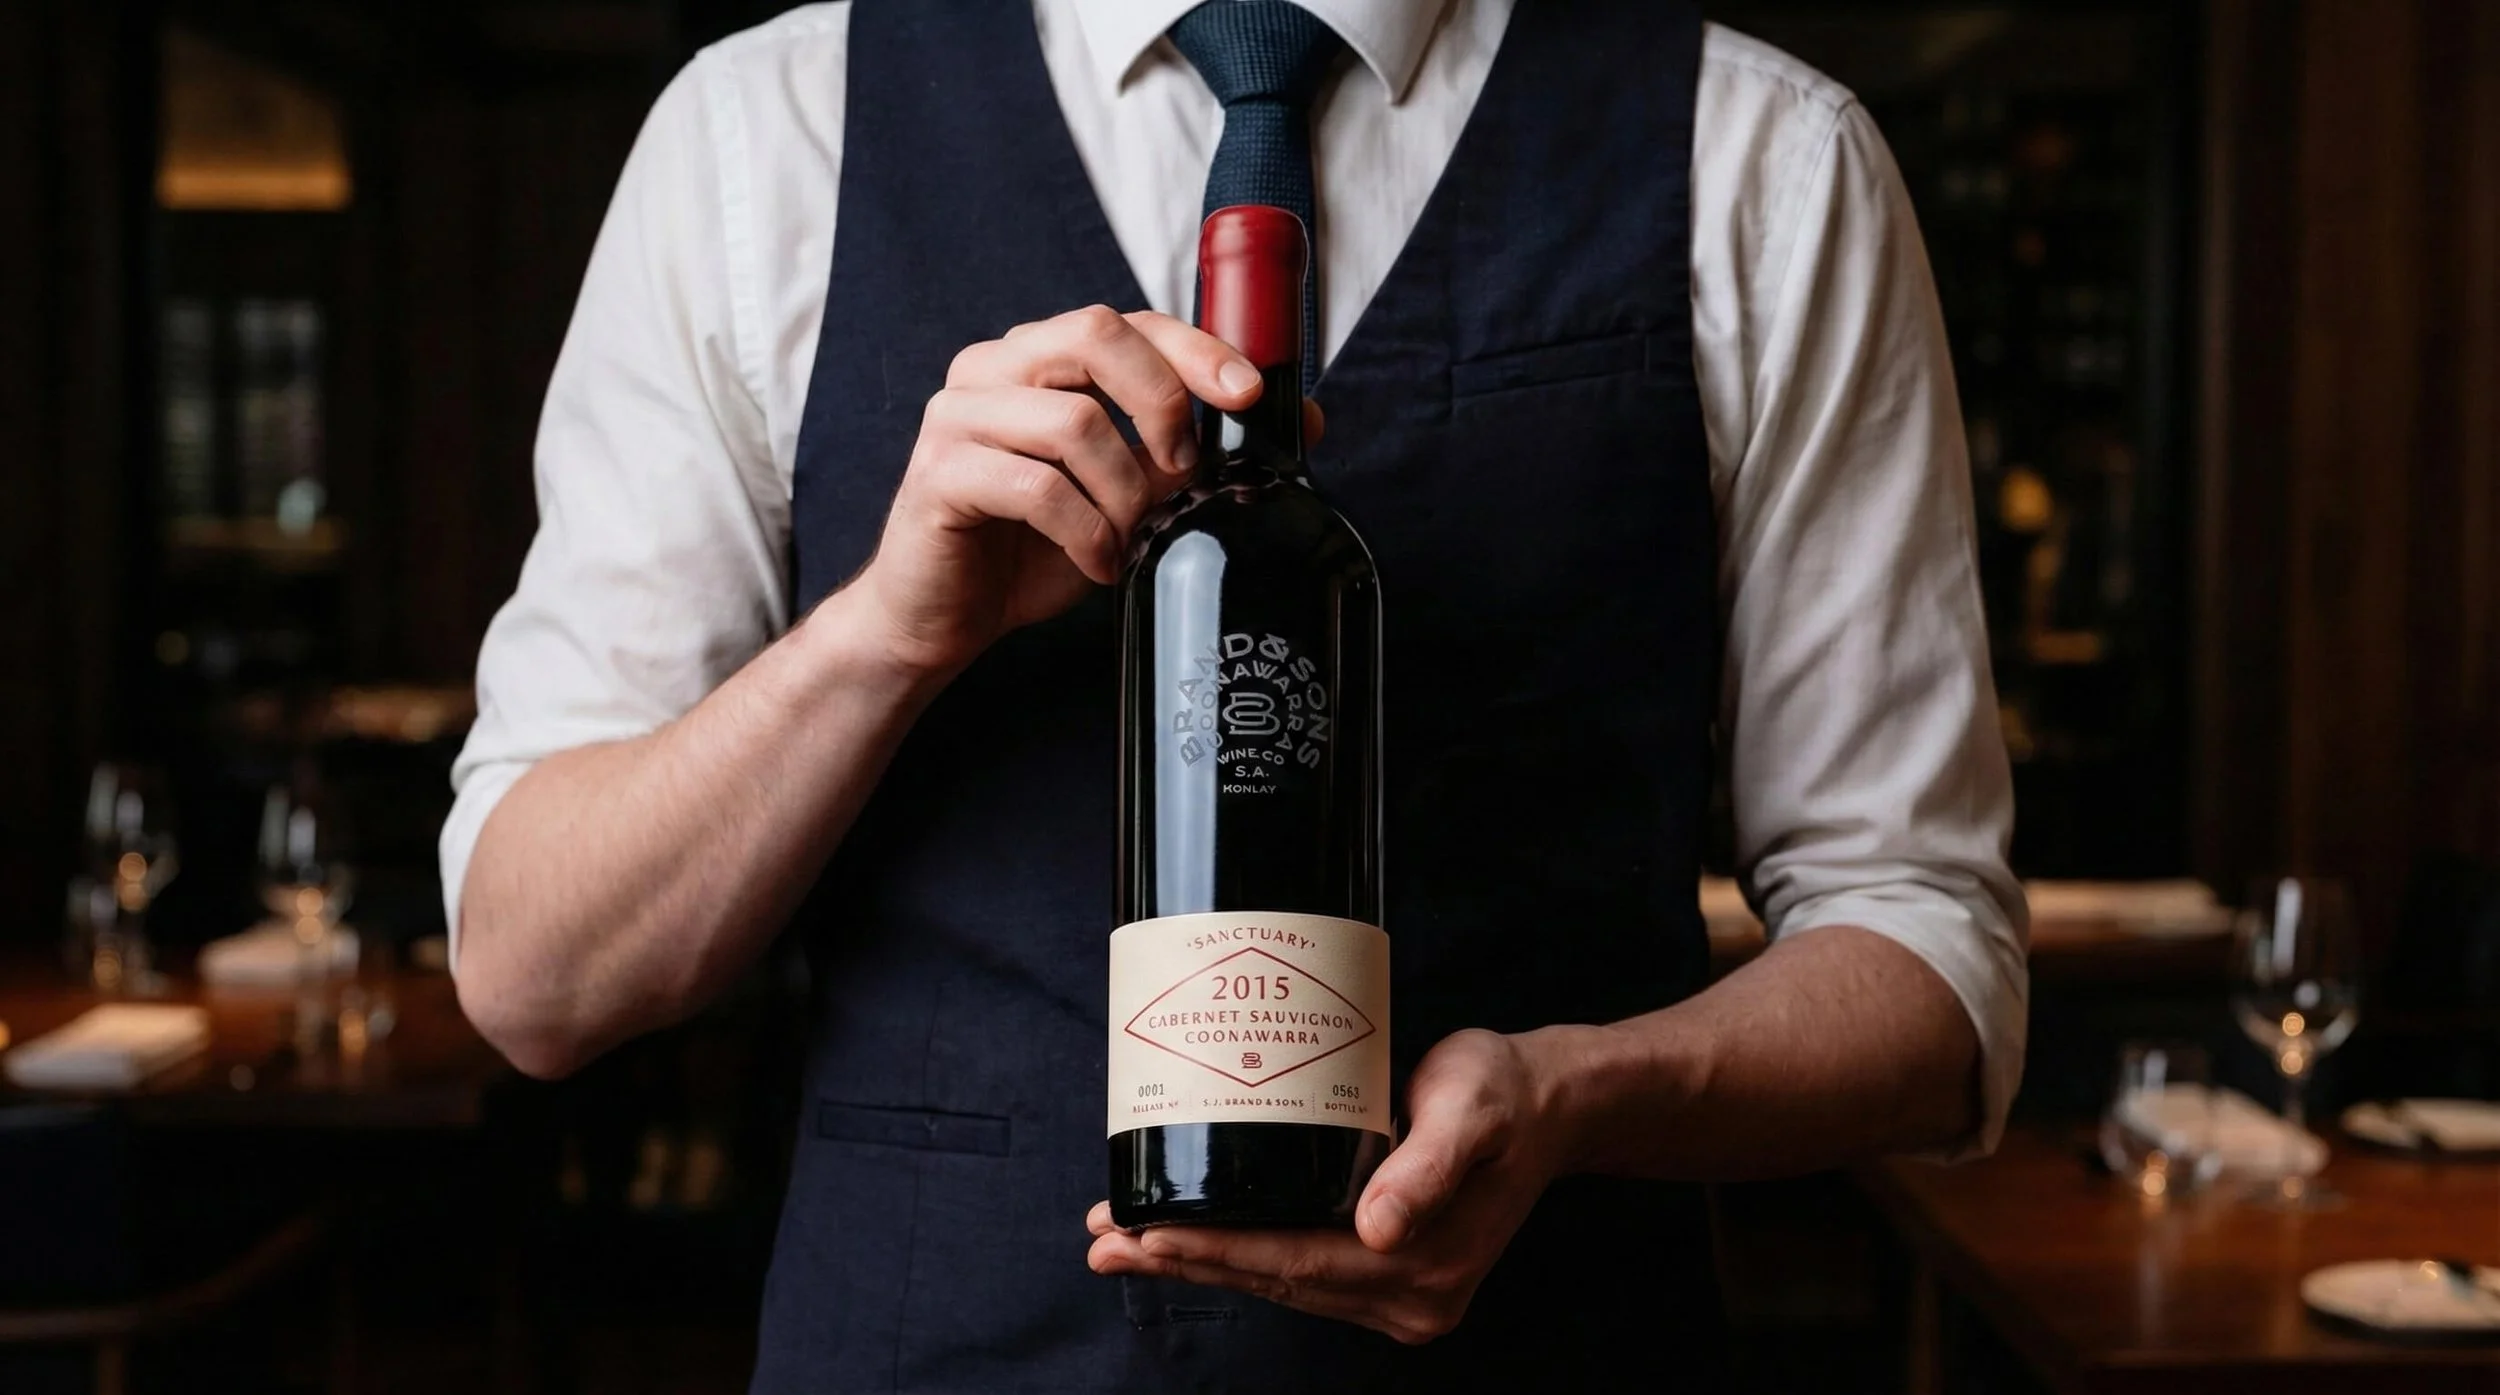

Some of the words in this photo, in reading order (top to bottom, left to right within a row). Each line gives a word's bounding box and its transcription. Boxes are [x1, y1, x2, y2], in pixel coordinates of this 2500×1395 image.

[1200, 660, 1304, 750] COONAWARRA
[1234, 765, 1270, 778] S.A.
[1223, 784, 1277, 794] KONLAY
[1212, 975, 1290, 1000] 2015
[1148, 1010, 1241, 1030] CABERNET
[1250, 1010, 1354, 1030] SAUVIGNON
[1185, 1030, 1320, 1045] COONAWARRA
[1138, 1083, 1165, 1098] 0001
[1332, 1084, 1360, 1099] 0563
[1225, 1098, 1263, 1107] BRAND
[1275, 1098, 1305, 1107] SONS
